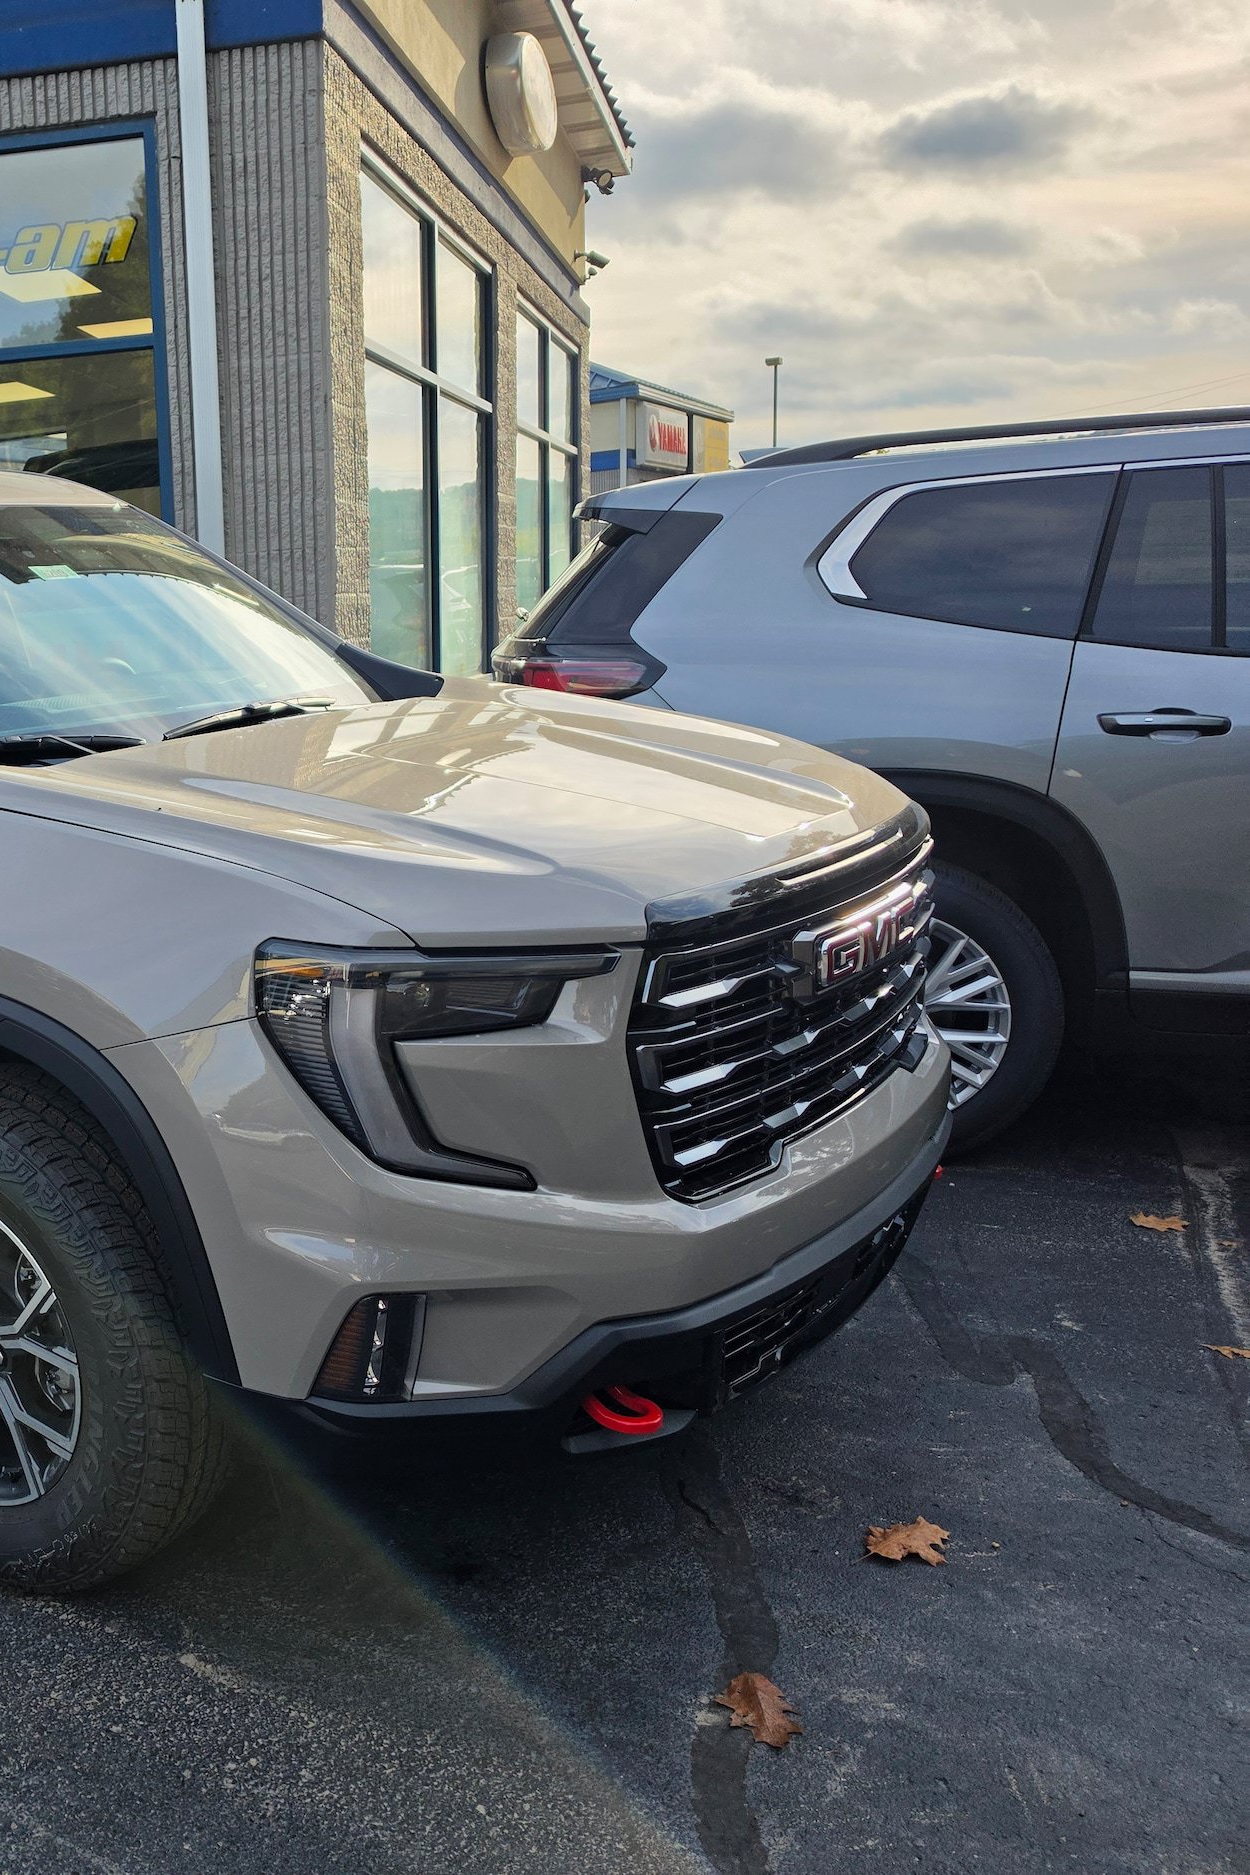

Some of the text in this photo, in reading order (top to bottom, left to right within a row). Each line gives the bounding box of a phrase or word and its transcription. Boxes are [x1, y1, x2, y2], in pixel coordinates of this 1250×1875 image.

[658, 421, 687, 455] YAMAHA
[821, 896, 914, 987] GMC
[52, 1326, 104, 1532] RANGLER
